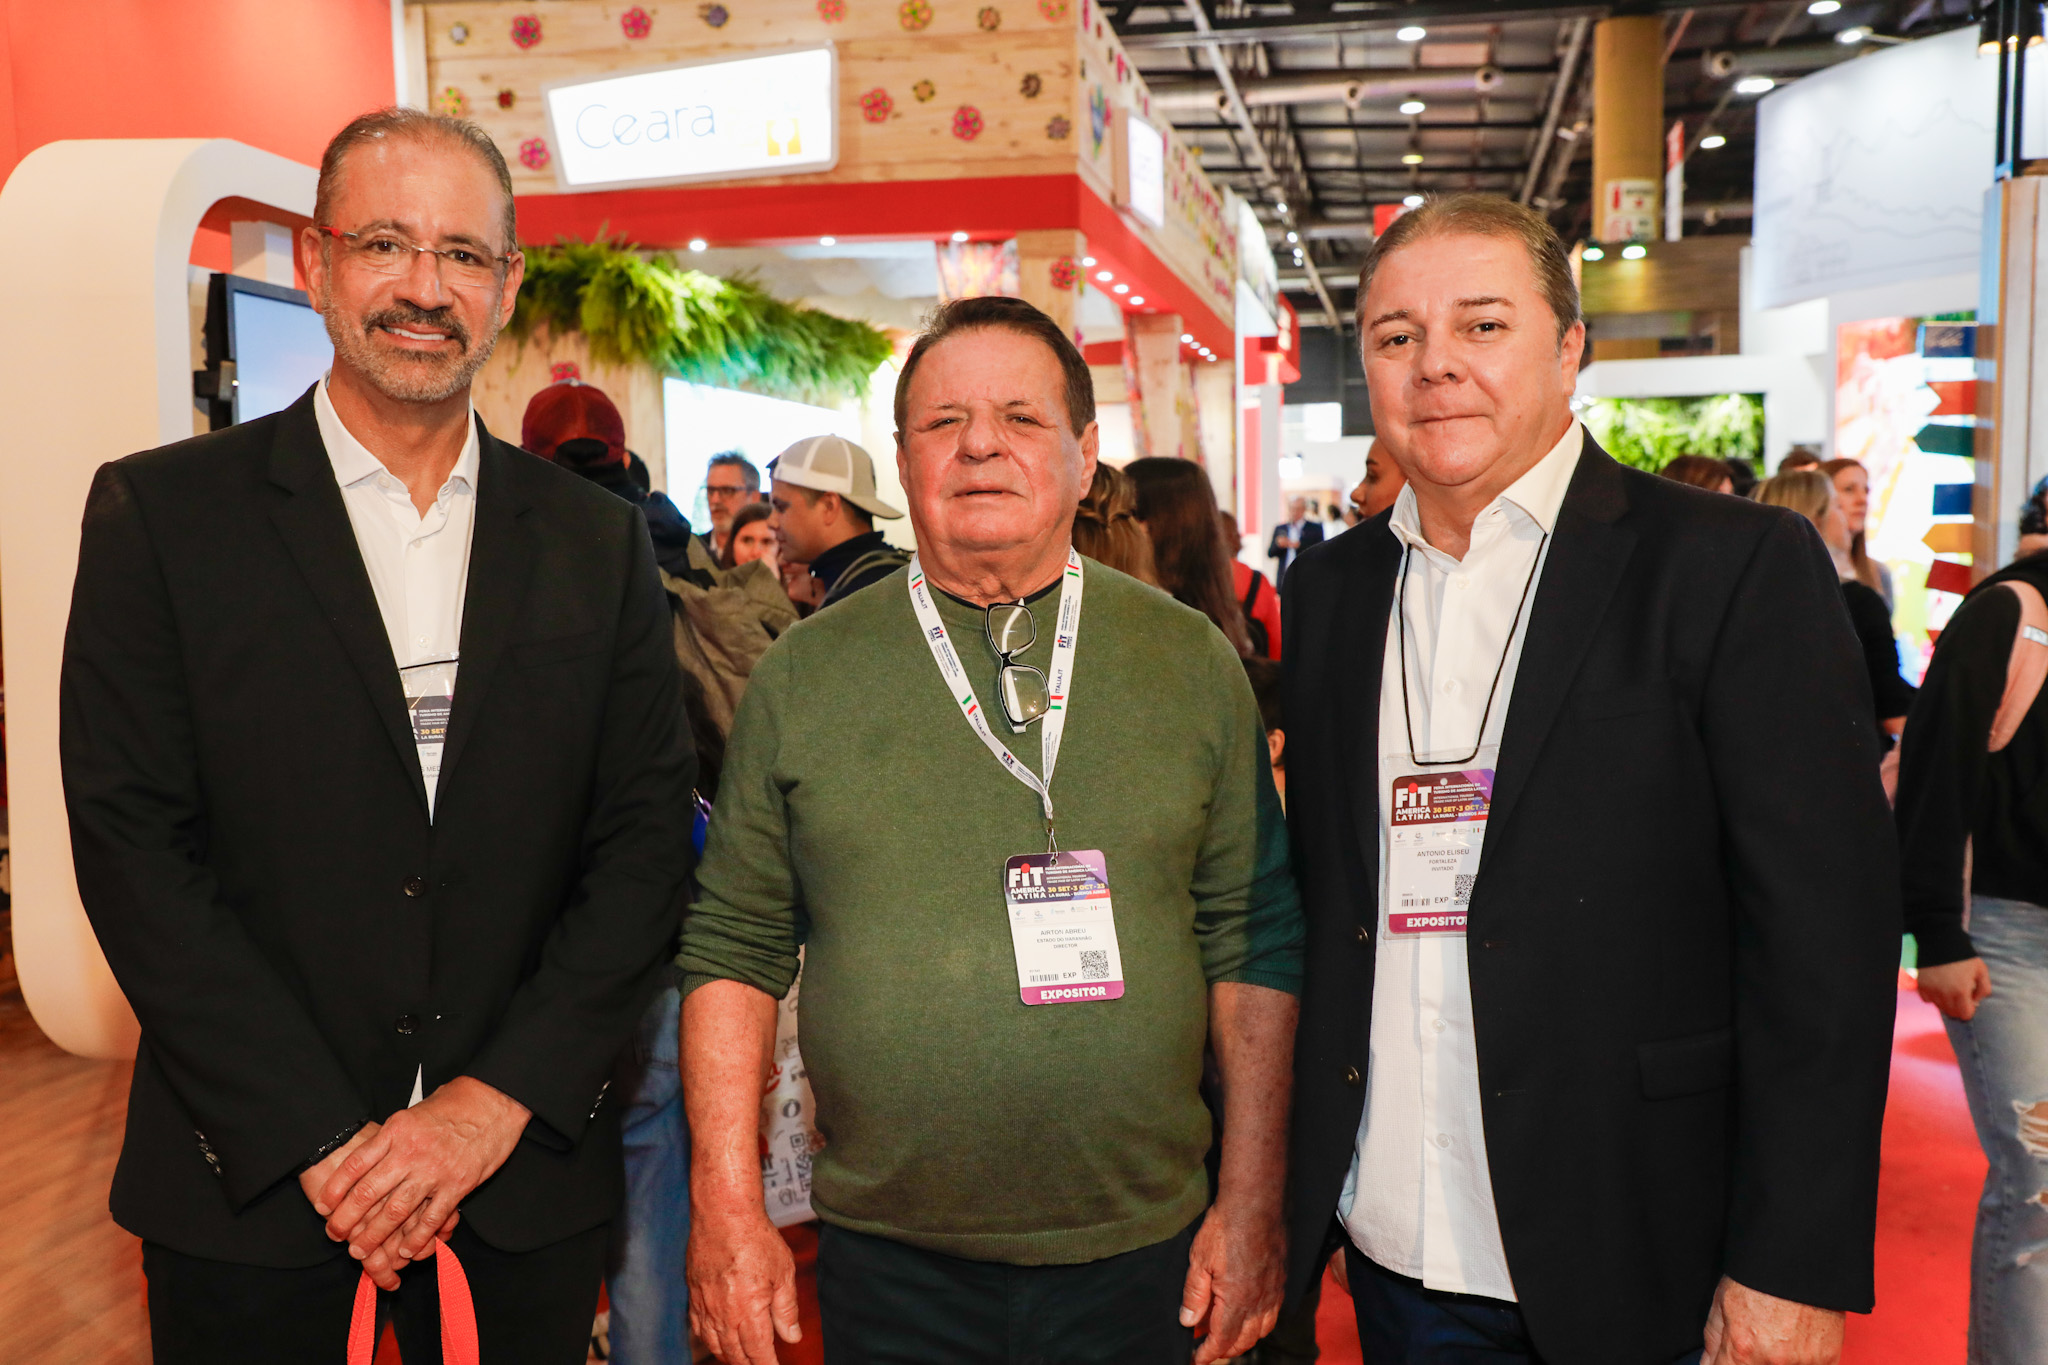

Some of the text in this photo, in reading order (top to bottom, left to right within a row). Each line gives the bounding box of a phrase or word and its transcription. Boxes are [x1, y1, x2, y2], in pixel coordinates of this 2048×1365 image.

[1055, 669, 1063, 694] ITALIA.IT
[1396, 807, 1431, 815] AMERICA
[1396, 813, 1431, 821] LATINA
[1011, 886, 1045, 895] AMERICA
[1012, 892, 1047, 900] LATINA
[1407, 916, 1467, 927] EXPOSITO
[1041, 987, 1106, 1000] EXPOSITOR
